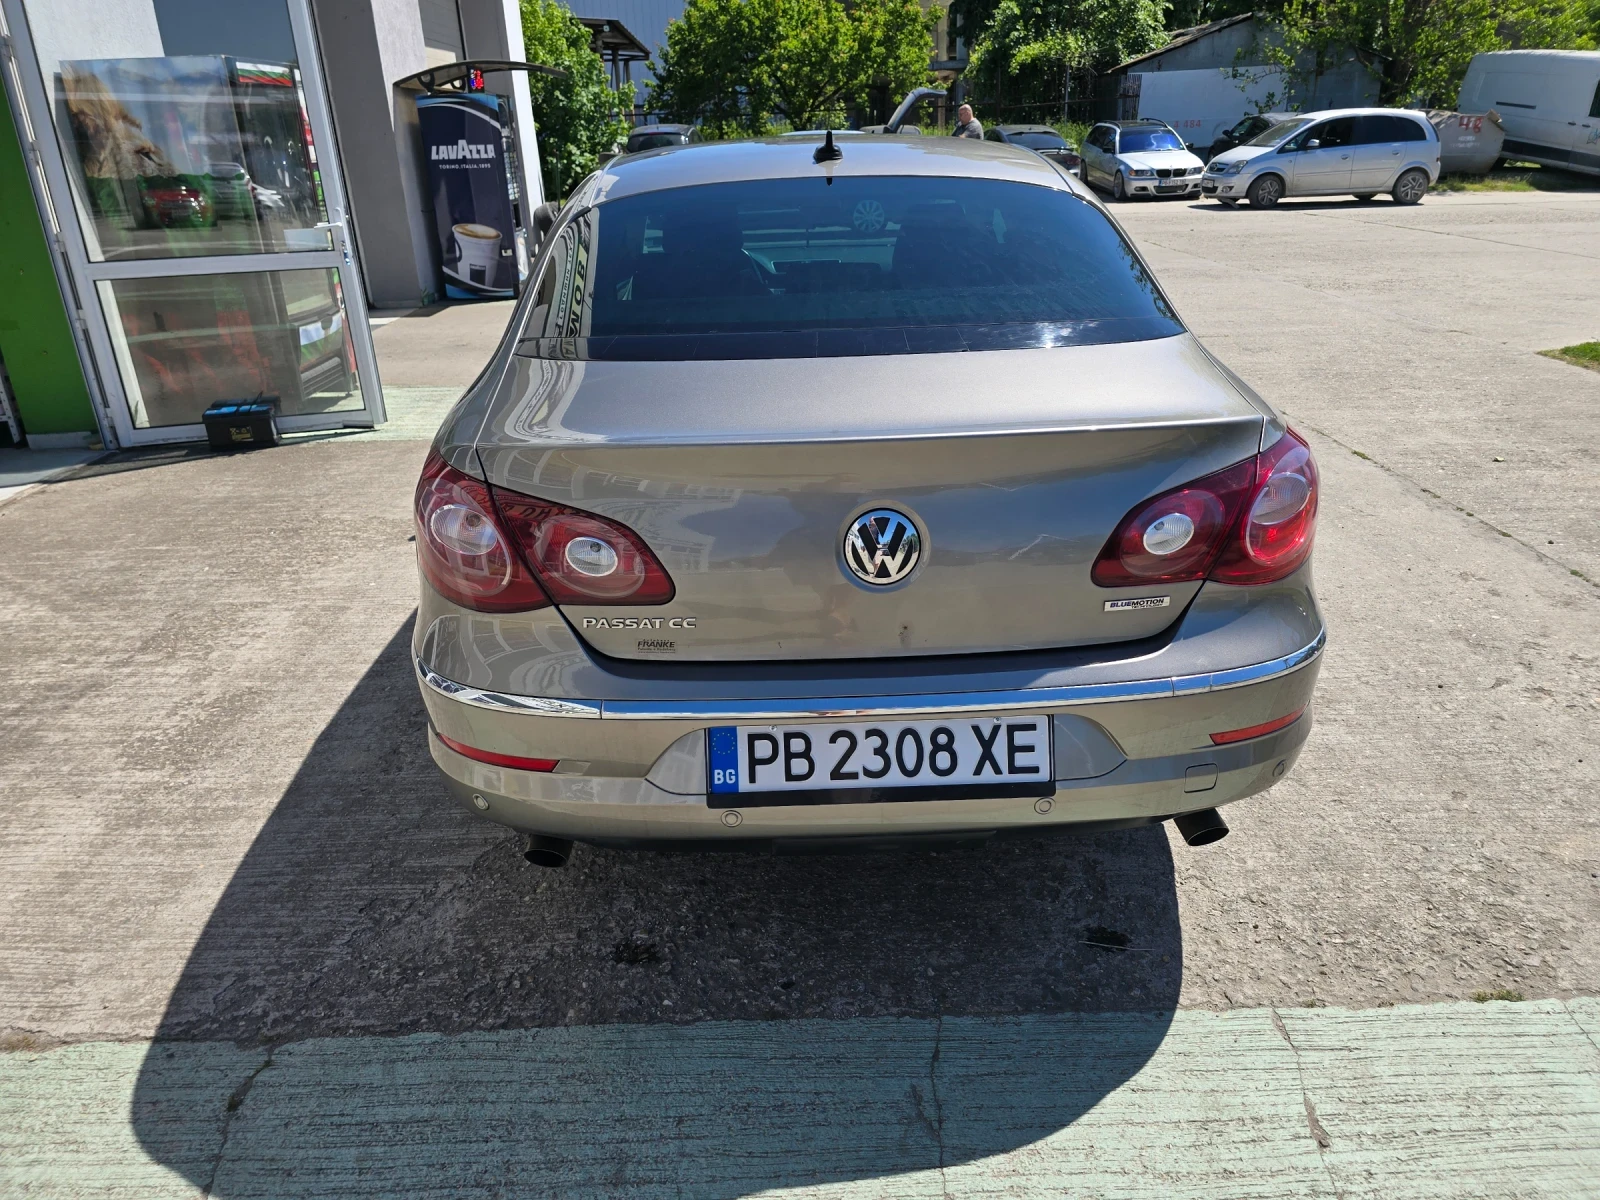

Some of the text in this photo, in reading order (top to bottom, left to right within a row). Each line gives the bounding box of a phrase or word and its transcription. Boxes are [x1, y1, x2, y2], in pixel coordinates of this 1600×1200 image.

[431, 139, 496, 160] LAVAZZA
[1109, 597, 1165, 608] BLUEMOTION
[582, 616, 697, 629] PASSAT CC
[747, 723, 1040, 784] PB 2308 XE
[713, 769, 737, 785] BG
